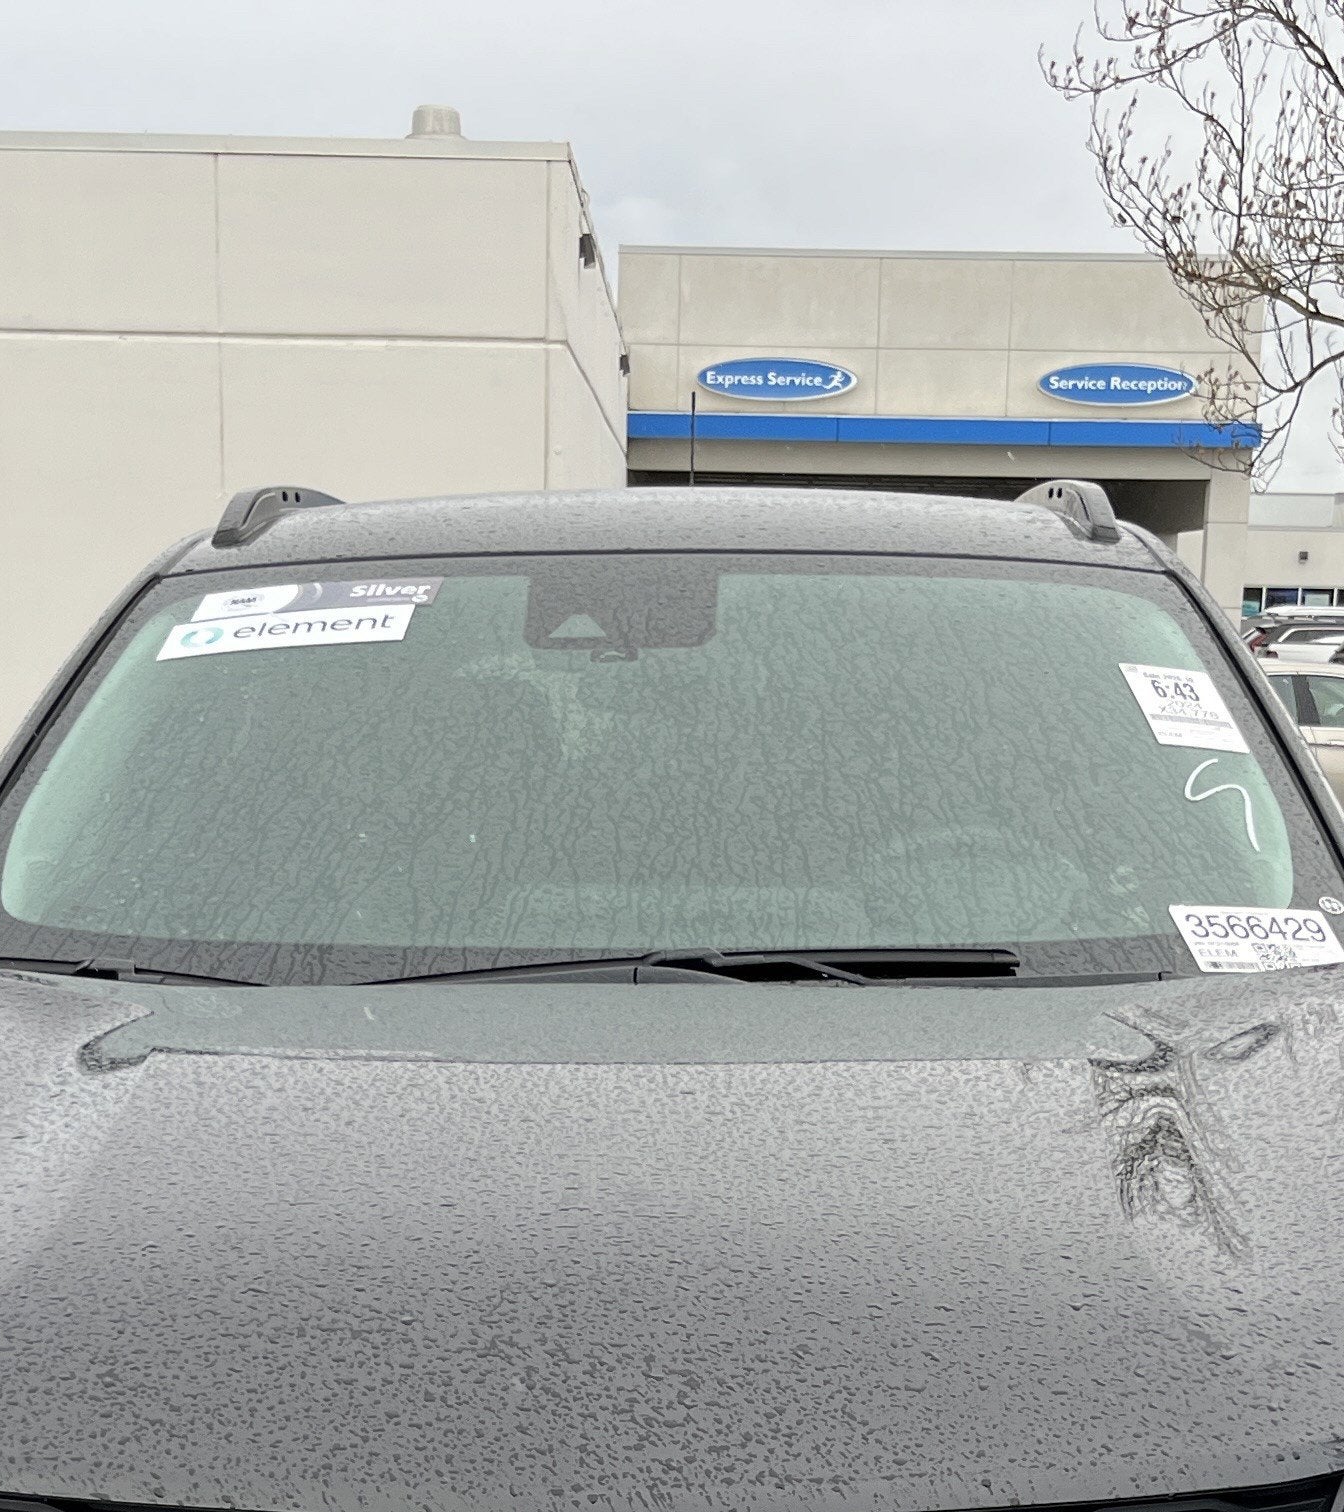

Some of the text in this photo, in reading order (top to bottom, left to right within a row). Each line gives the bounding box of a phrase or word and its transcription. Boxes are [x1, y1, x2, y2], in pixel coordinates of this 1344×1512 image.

[706, 371, 823, 389] Express Service
[1049, 376, 1187, 394] Service Reception
[233, 614, 395, 639] element
[1151, 679, 1200, 702] 6:43
[1185, 913, 1326, 943] 3566429
